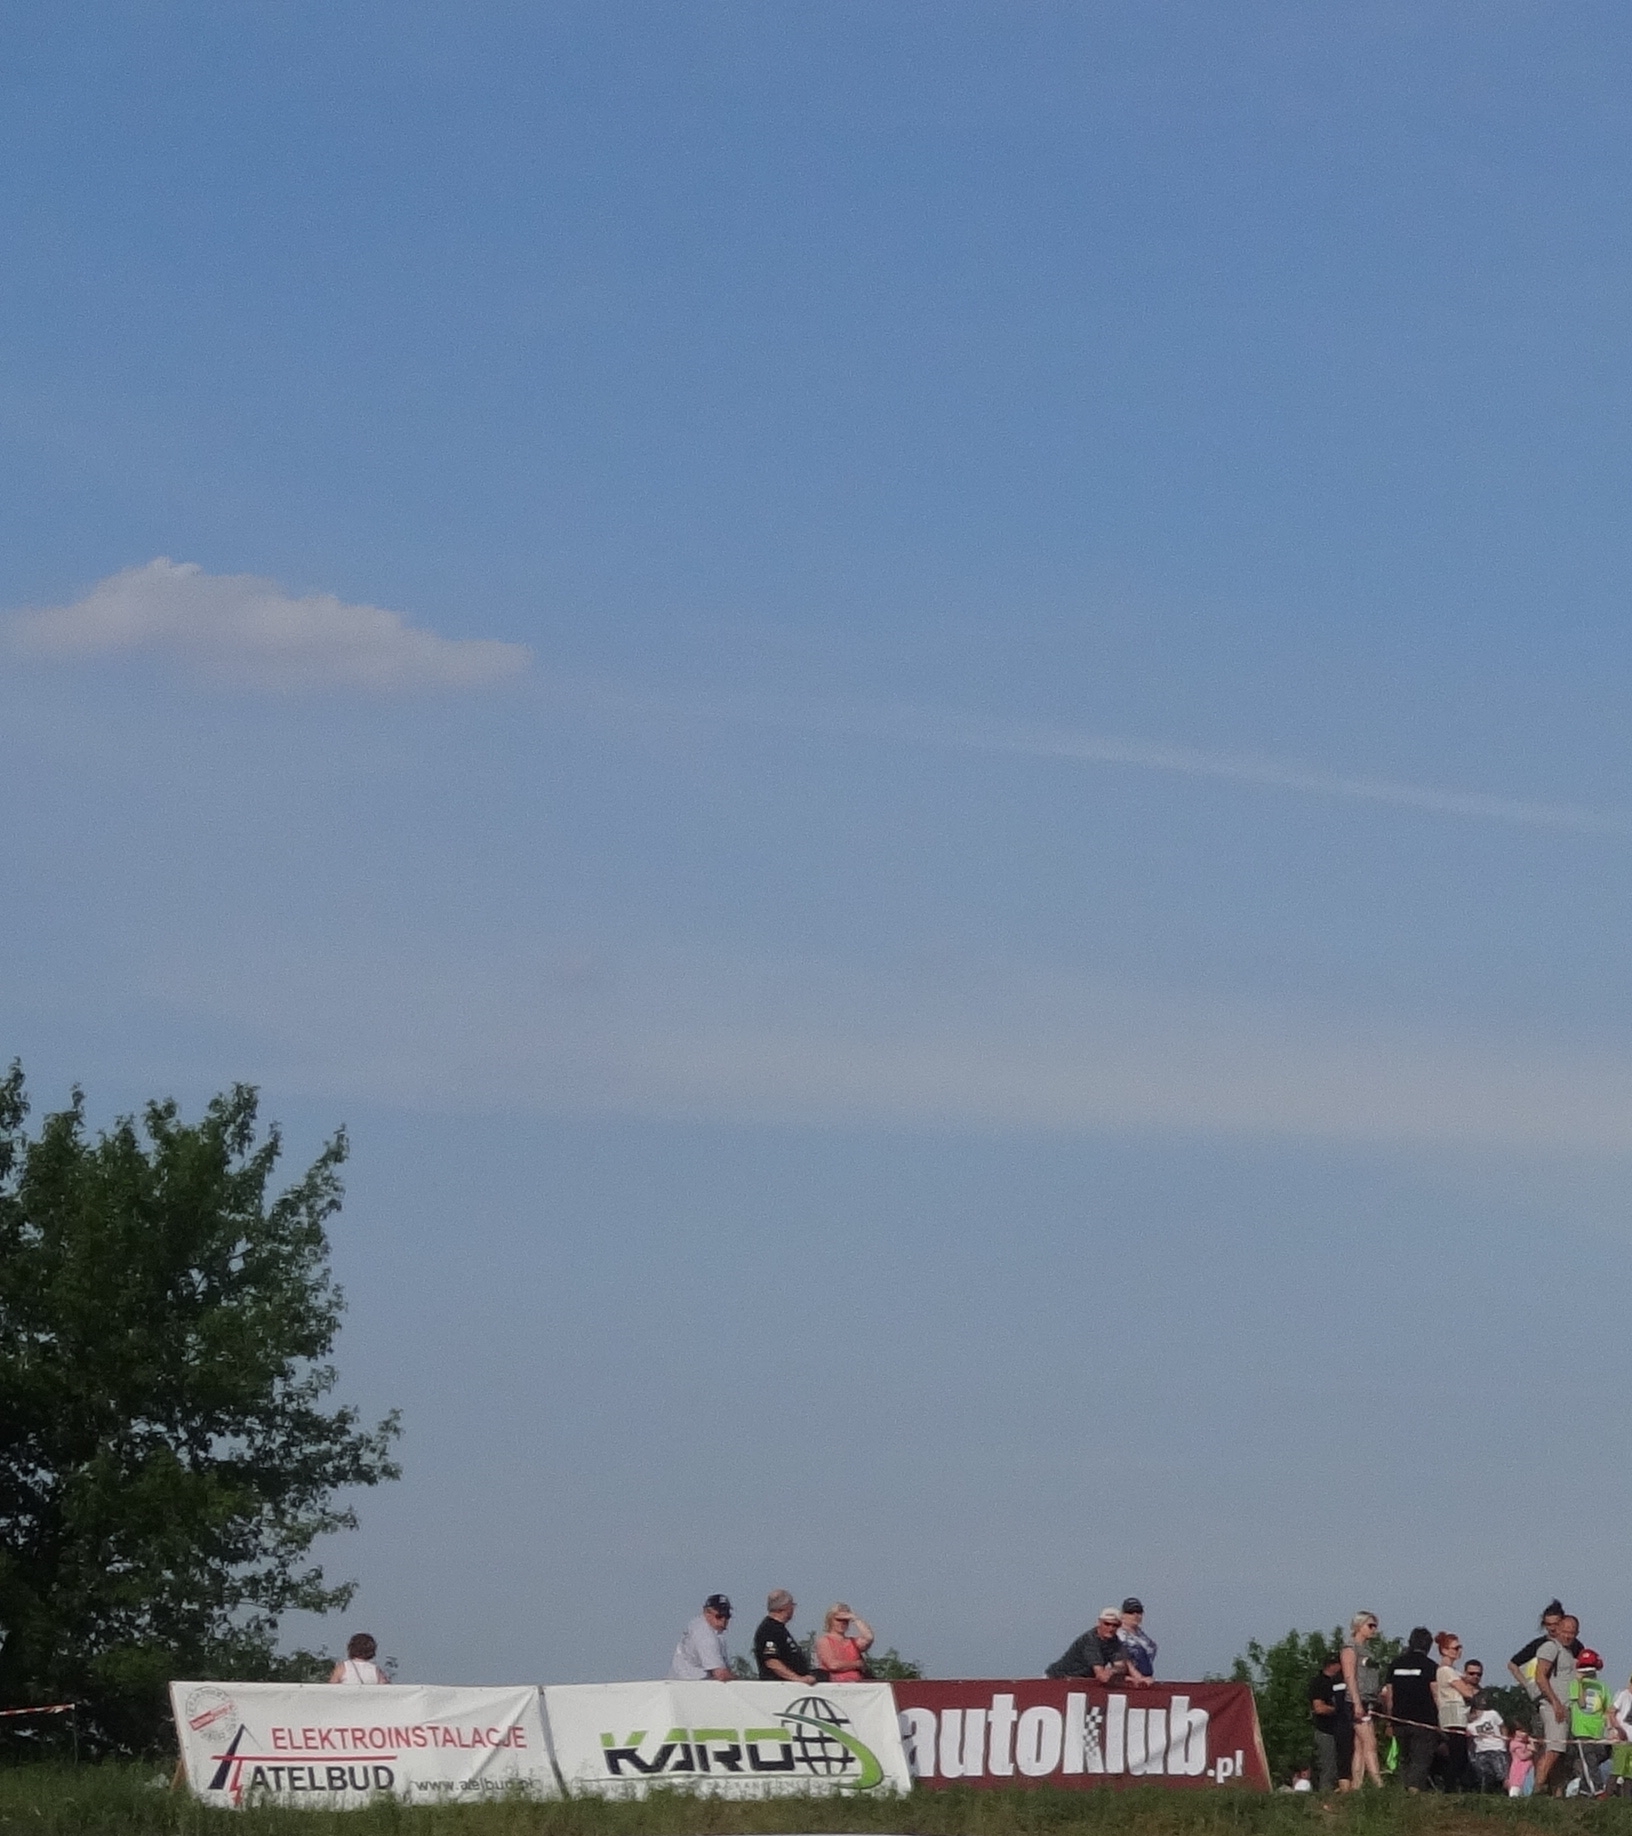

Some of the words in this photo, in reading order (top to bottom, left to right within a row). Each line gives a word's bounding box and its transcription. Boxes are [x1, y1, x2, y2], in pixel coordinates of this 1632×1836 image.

[271, 1726, 527, 1750] ELEKTROINSTALACJE
[600, 1727, 793, 1775] KARO
[899, 1692, 1244, 1783] autoklub.pl
[250, 1765, 395, 1792] ATELBUD
